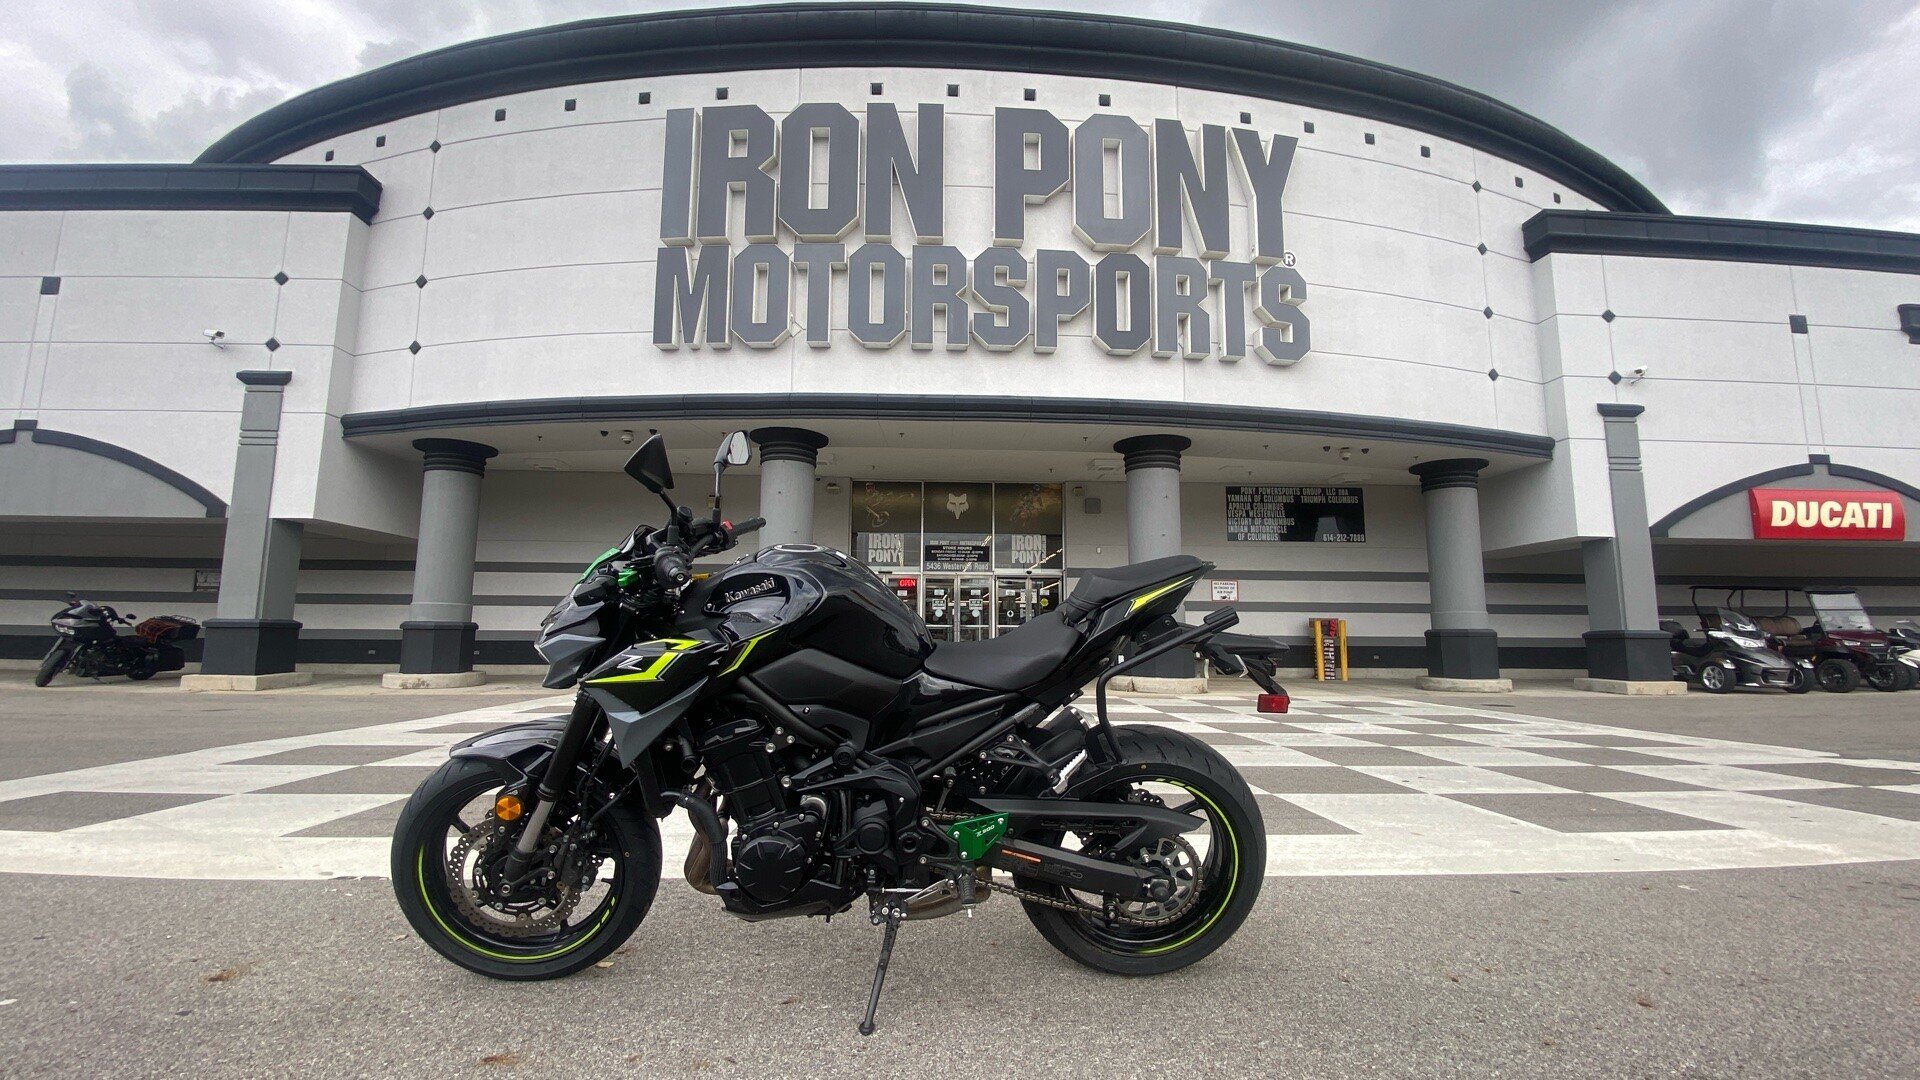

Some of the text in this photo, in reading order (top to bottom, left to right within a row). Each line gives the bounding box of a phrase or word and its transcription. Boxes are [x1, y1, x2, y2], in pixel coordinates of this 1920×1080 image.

[660, 103, 1298, 264] IRON PONY
[653, 244, 1311, 366] MOTORSPORTS
[1258, 487, 1300, 495] POWERSPORTS
[1771, 501, 1893, 528] DUCATI
[868, 533, 899, 548] IRON
[1011, 534, 1042, 550] IRON
[1247, 533, 1279, 541] COLUMBUS
[868, 549, 899, 562] PONY
[1011, 551, 1041, 563] PONY
[926, 562, 941, 570] 5436
[942, 562, 973, 570] Westerve
[724, 577, 775, 603] Kawasaki
